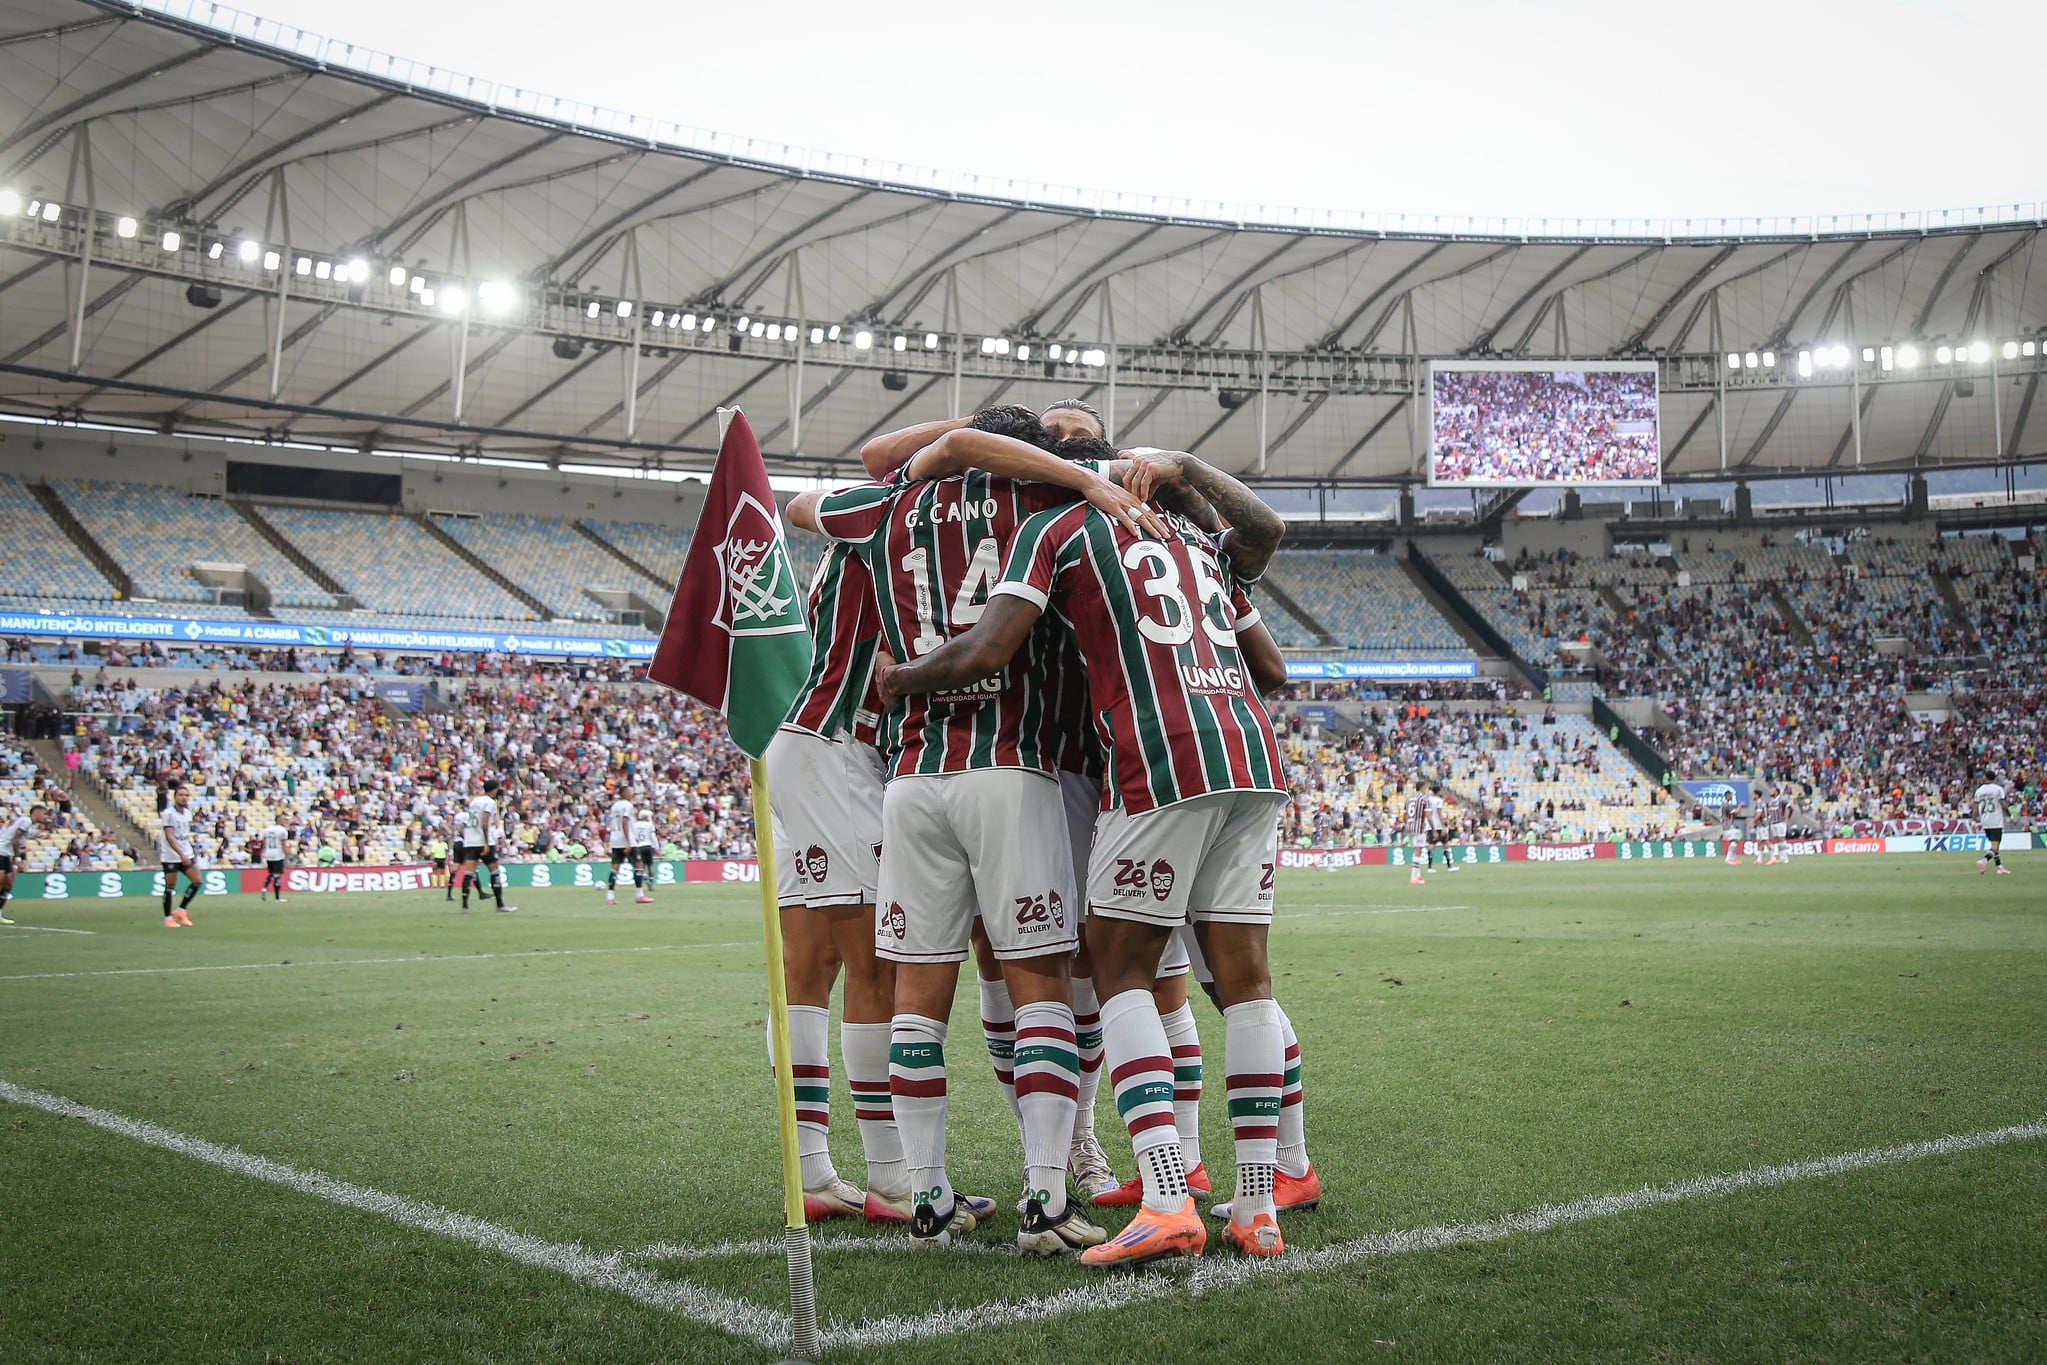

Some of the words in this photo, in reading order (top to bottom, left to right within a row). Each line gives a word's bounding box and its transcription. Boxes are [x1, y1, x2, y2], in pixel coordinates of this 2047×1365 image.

[905, 509, 924, 528] G.
[929, 498, 998, 525] CANO
[902, 537, 1000, 655] 14
[1123, 540, 1237, 648] 35
[1, 617, 93, 634] MANUTENÇÃO
[95, 621, 173, 635] INTELIGENTE
[244, 626, 254, 638] A
[253, 627, 300, 640] CAMISA
[350, 631, 428, 648] MANUTENÇÃO
[429, 635, 495, 648] INTELIGENTE
[563, 641, 602, 652] CAMISA
[1182, 665, 1242, 689] UNIG
[932, 694, 976, 702] UNIVERSIDADE
[1408, 800, 1416, 817] 6
[1527, 843, 1595, 861] SUPERBET
[1834, 841, 1880, 854] Betano
[288, 867, 433, 892] SUPERBET
[1113, 858, 1148, 888] Zé
[1113, 888, 1147, 898] DELIVERY
[1015, 894, 1050, 925] Zé
[1018, 923, 1051, 934] DELIVERY
[902, 1048, 931, 1057] FFC
[1016, 1048, 1044, 1059] FFC
[1144, 1087, 1170, 1096] FFC
[1255, 1101, 1278, 1109] FFC
